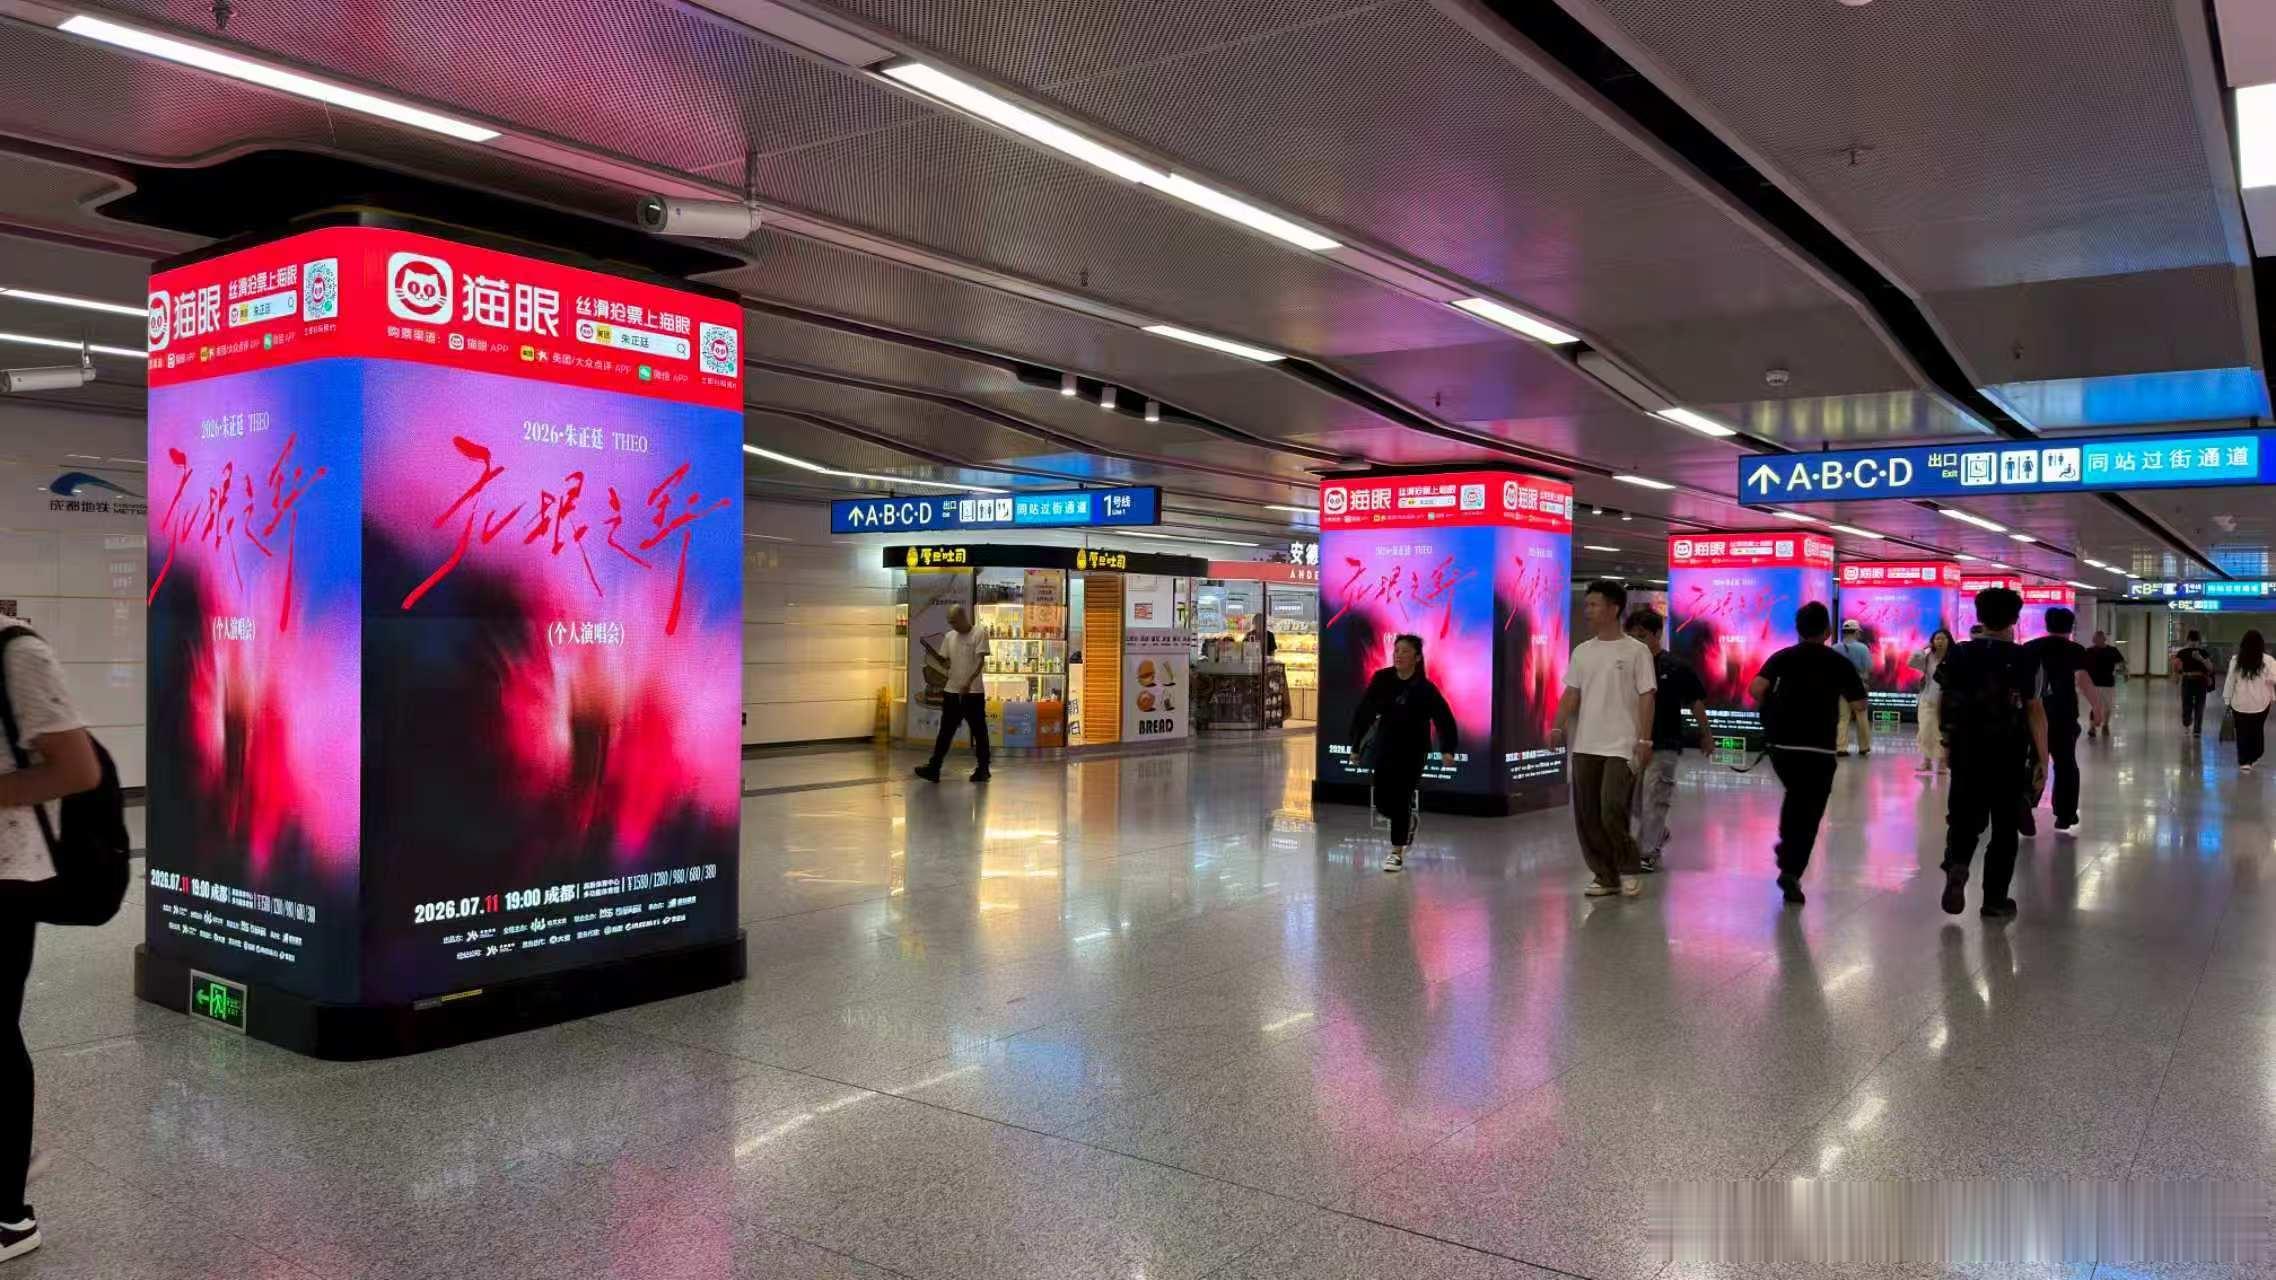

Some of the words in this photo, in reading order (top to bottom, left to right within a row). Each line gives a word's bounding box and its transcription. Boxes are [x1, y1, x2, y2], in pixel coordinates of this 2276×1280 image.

[228, 264, 298, 300] 丝滑抢票上猫眼
[174, 284, 221, 340] 猫眼
[462, 274, 560, 338] 猫眼
[576, 295, 691, 335] 丝滑抢票上猫眼
[523, 420, 604, 450] 2026·朱正廷
[612, 431, 649, 453] THEO
[1927, 453, 1958, 468] 出口
[2087, 446, 2250, 473] 同站过街通道
[1942, 470, 1958, 479] Exit
[50, 500, 109, 513] 成都地铁
[1350, 487, 1392, 511] 猫眼
[547, 620, 625, 649] (个人演唱会)
[1138, 719, 1174, 735] BREAD
[191, 878, 210, 899] 19:00
[414, 894, 499, 924] 2026.07.11
[505, 887, 541, 911] 19:00
[544, 883, 576, 905] 成都
